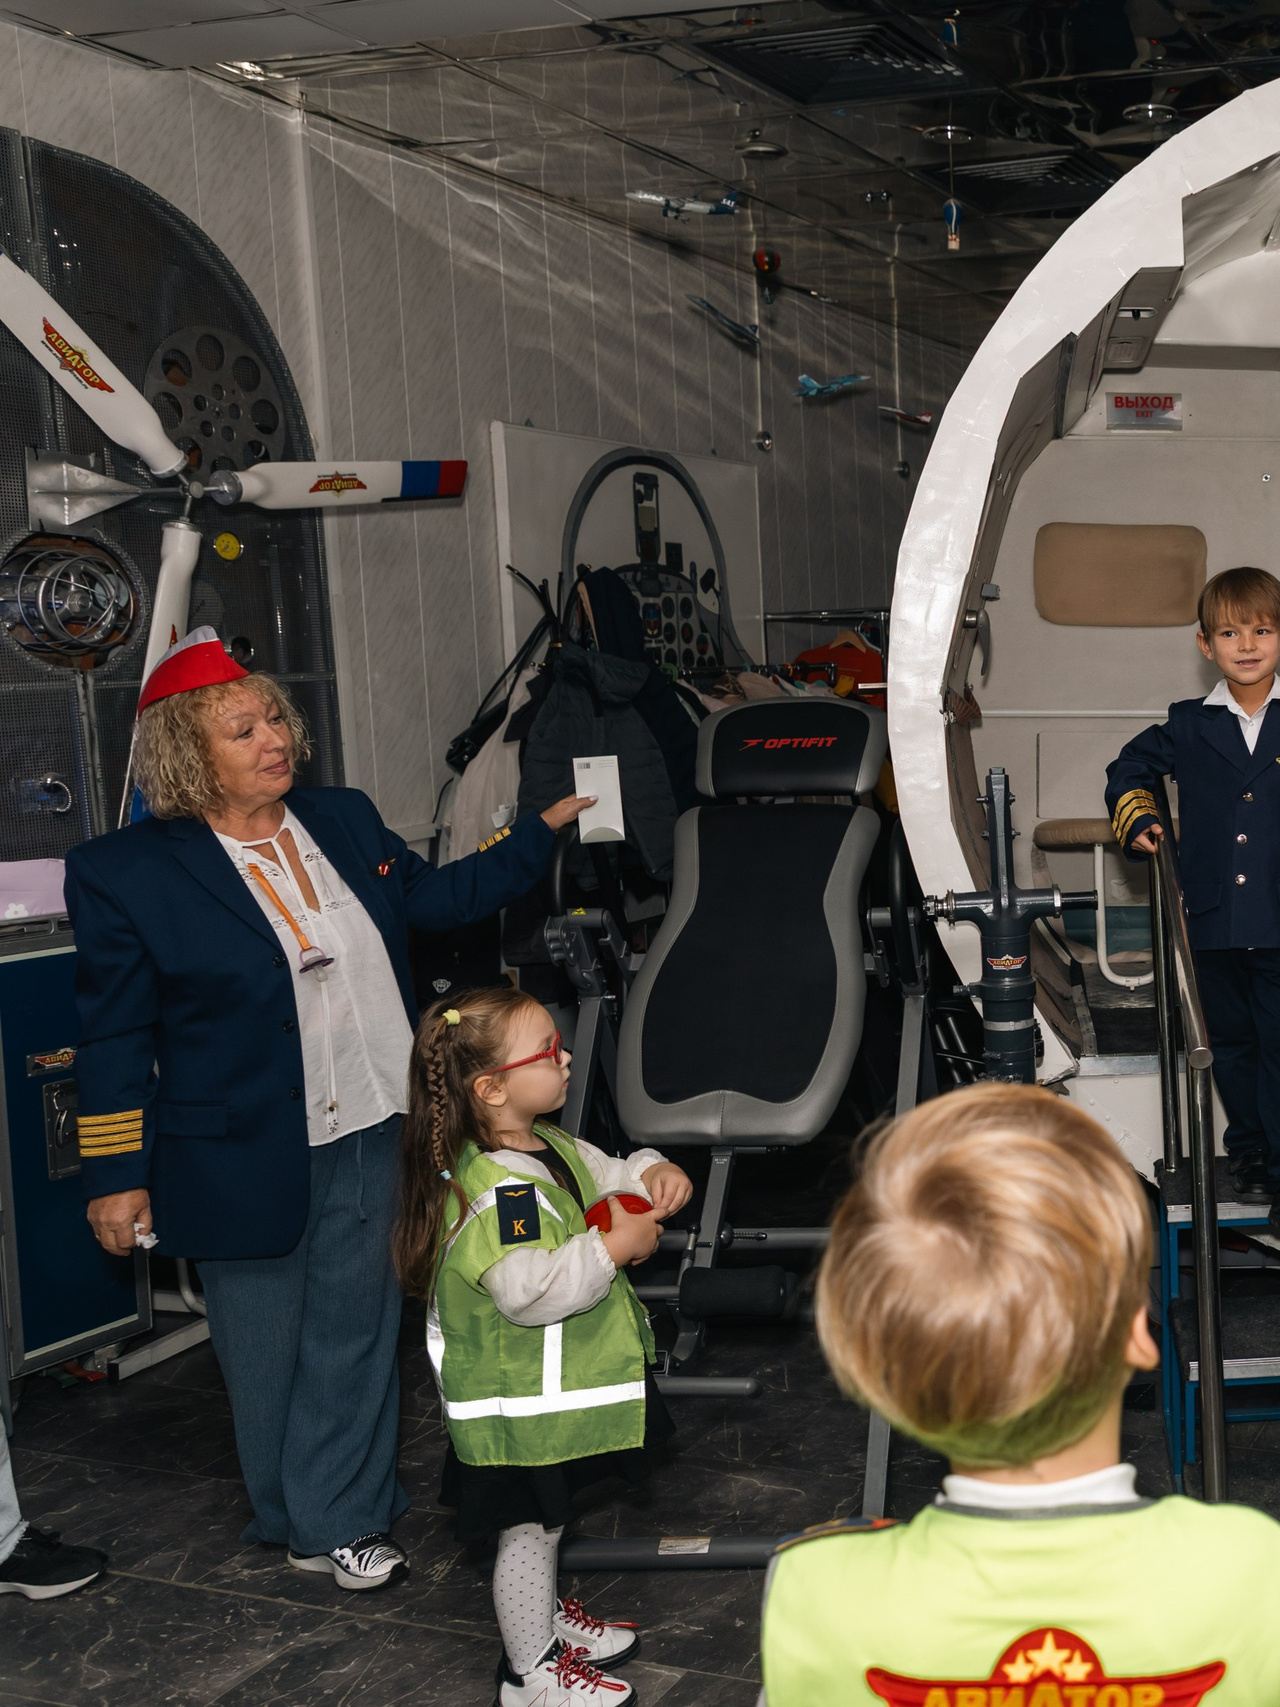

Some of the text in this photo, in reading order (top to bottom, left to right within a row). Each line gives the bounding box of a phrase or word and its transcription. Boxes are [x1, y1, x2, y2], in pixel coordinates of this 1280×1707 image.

[48, 333, 100, 383] АВИАТОР
[1114, 395, 1174, 411] ВЫХОД
[1135, 410, 1154, 418] EXIT
[318, 480, 358, 490] АВИАТОР
[764, 737, 838, 749] OPTIFIT
